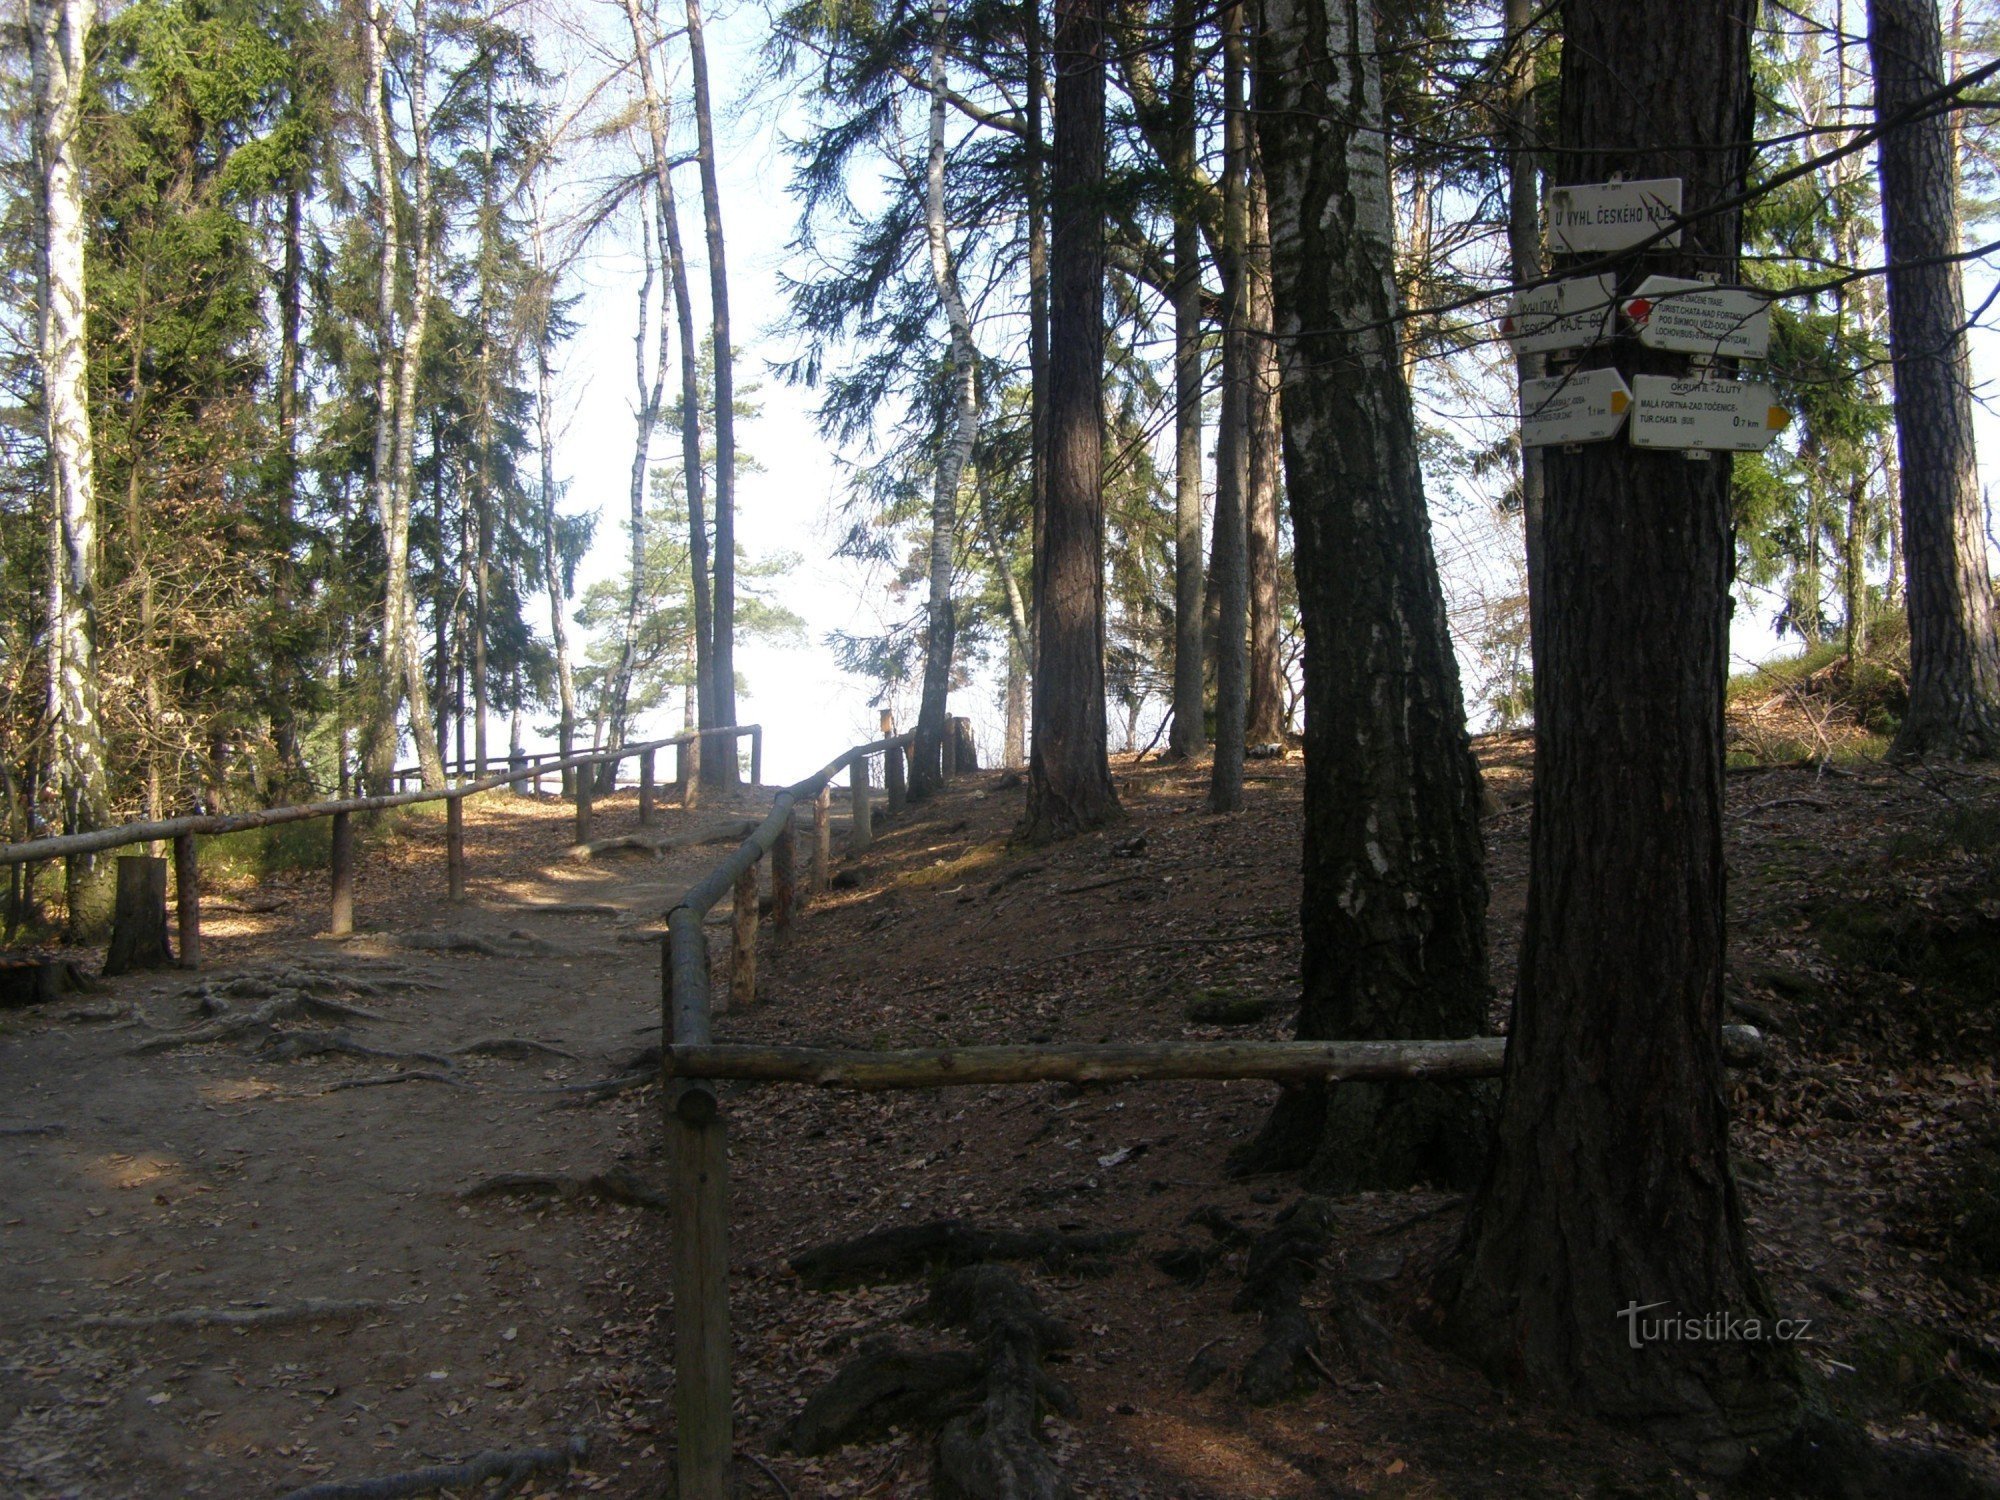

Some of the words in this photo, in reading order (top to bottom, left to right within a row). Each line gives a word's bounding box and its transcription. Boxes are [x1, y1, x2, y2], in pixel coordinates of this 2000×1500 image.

[1556, 211, 1563, 226] U
[1597, 203, 1643, 225] ČESKÉHO
[1658, 315, 1672, 325] POD
[1716, 383, 1742, 394] ŽLUTÝ
[1641, 398, 1659, 408] MALÁ
[1747, 418, 1759, 428] km
